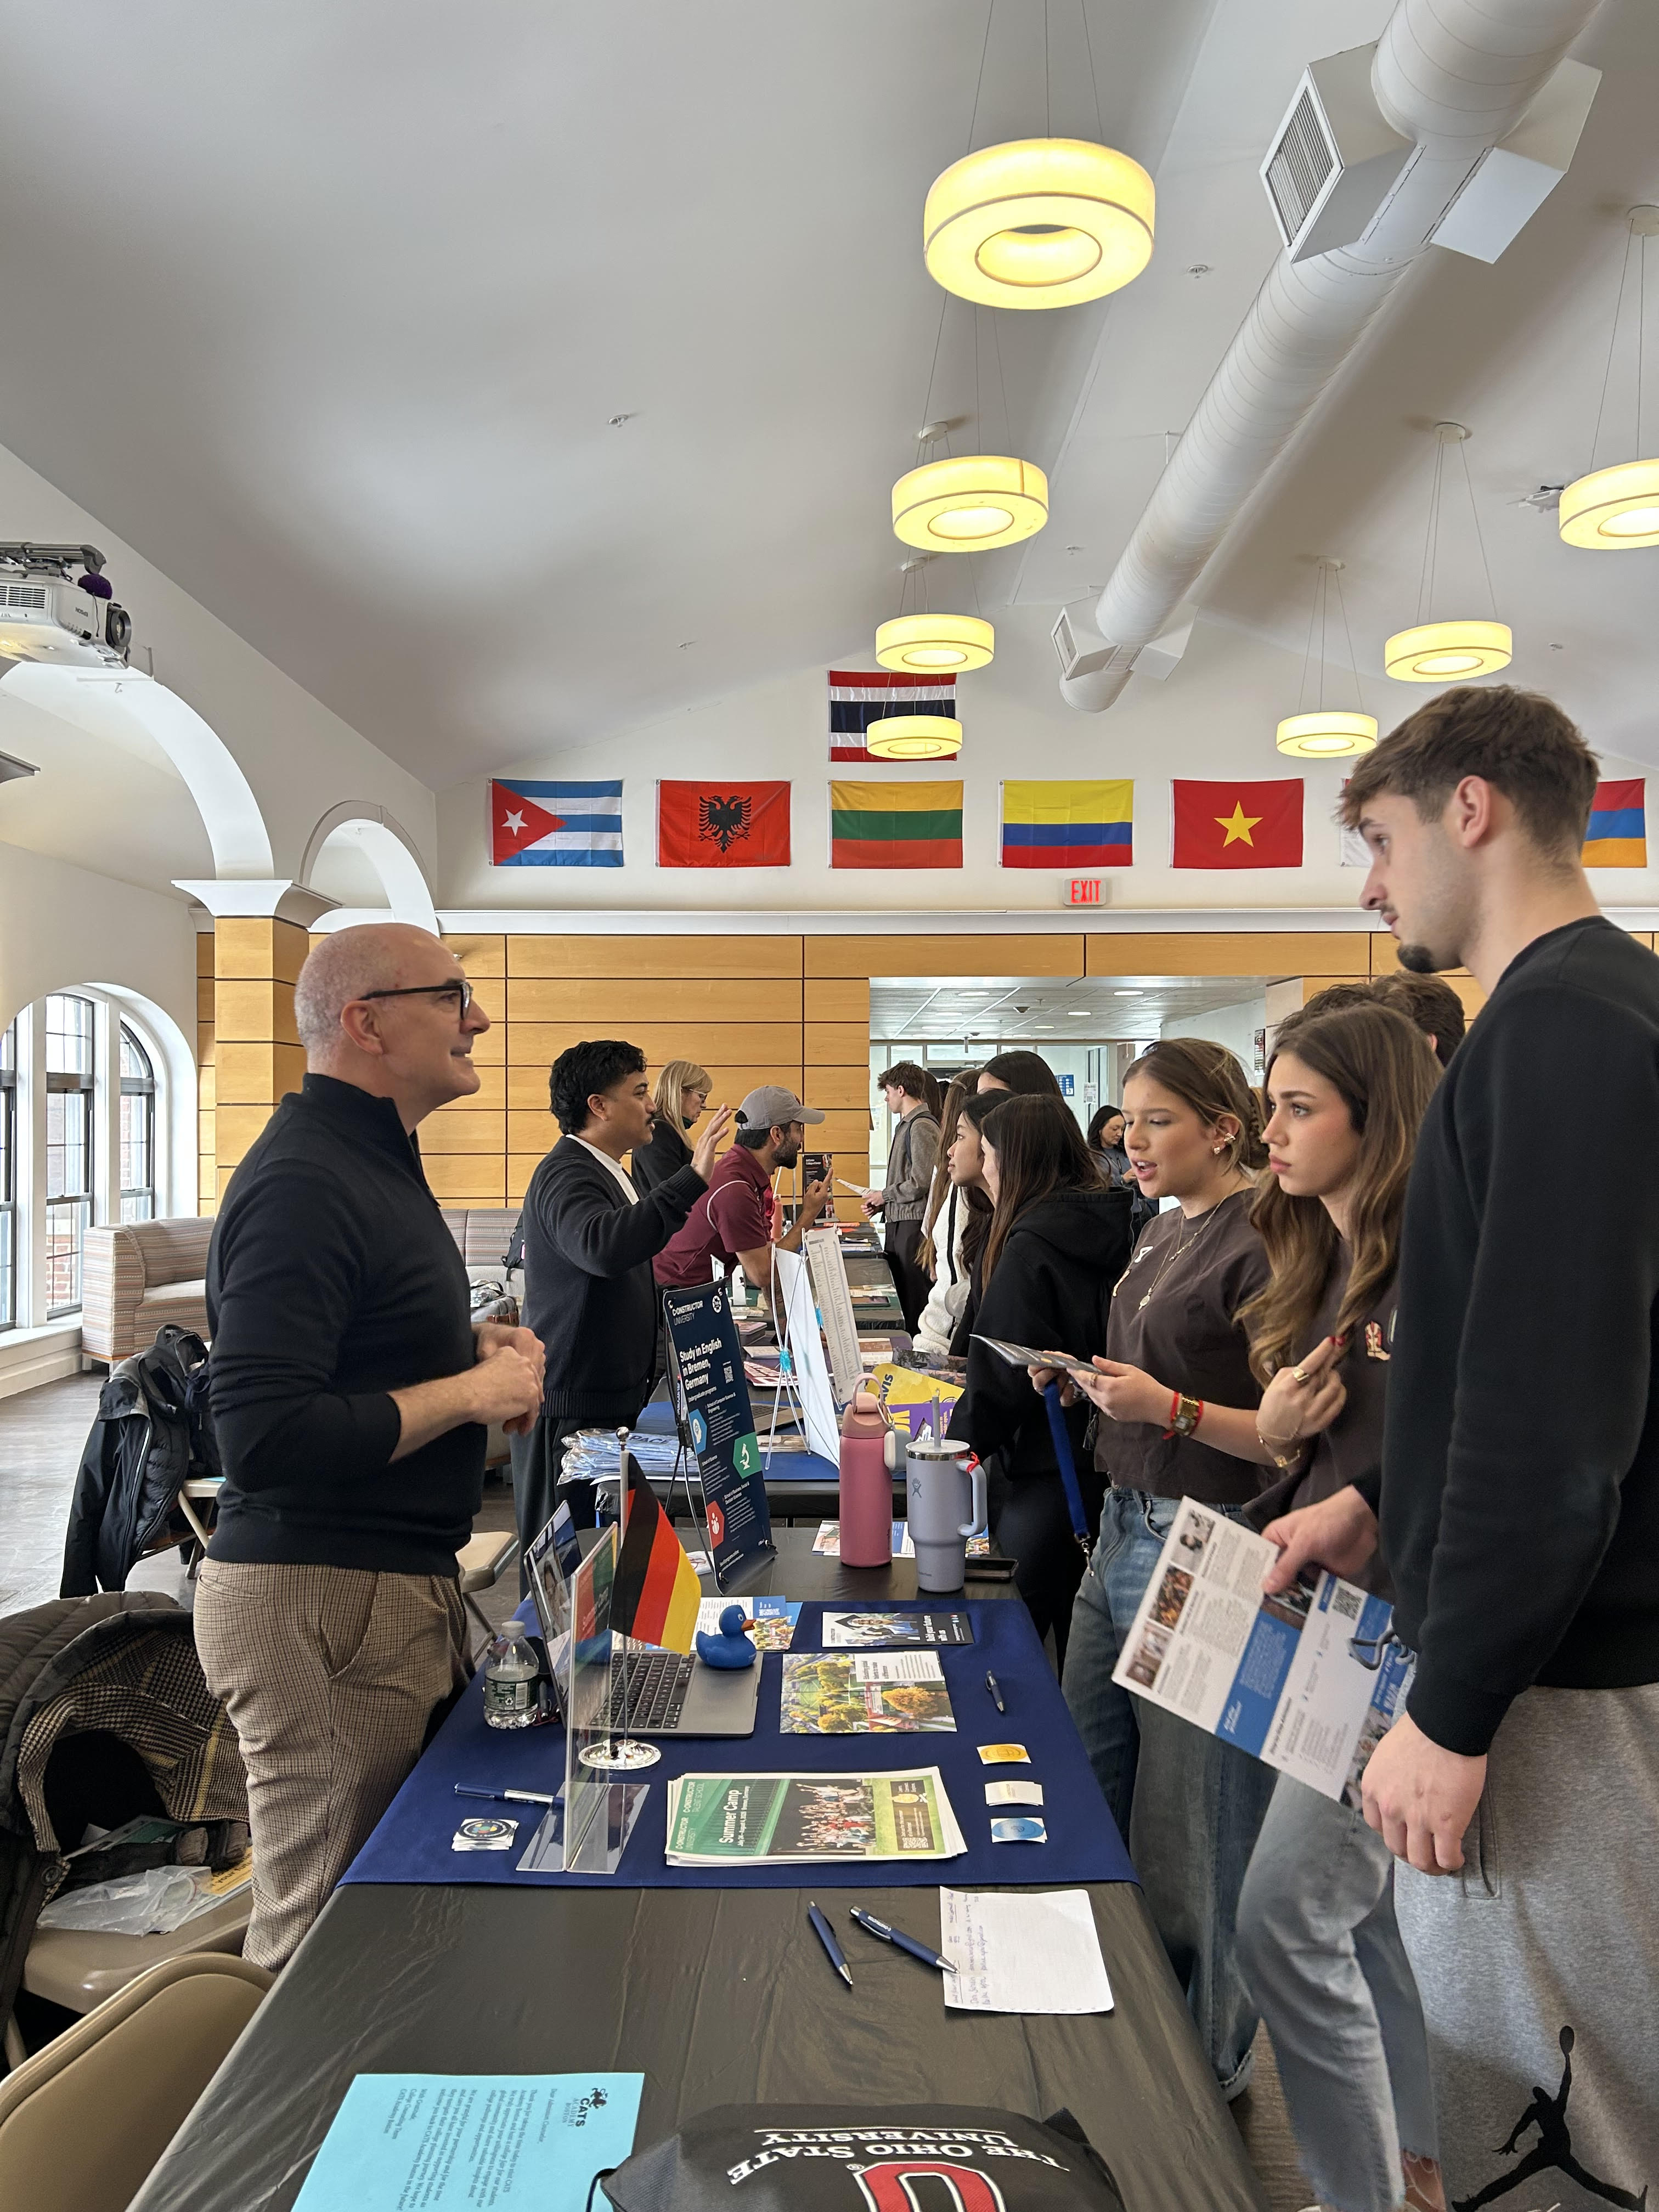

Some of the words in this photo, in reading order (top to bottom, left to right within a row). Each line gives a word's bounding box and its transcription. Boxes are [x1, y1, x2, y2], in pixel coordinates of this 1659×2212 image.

[1071, 880, 1101, 904] EXIT
[673, 1312, 695, 1325] UNIVERSITY
[680, 1346, 696, 1363] Study
[695, 1344, 702, 1356] in
[701, 1338, 722, 1355] English
[682, 1365, 688, 1376] in
[687, 1359, 711, 1374] Bremen,
[685, 1373, 709, 1390] Germany
[694, 1782, 705, 1798] SCHOOL
[691, 1798, 702, 1813] TALENT
[723, 1790, 742, 1810] Camp
[719, 1812, 736, 1843] Summer
[215, 1871, 235, 1883] your
[397, 2089, 407, 2100] CATS
[405, 2089, 417, 2103] College
[549, 2089, 558, 2098] Dear
[389, 2101, 402, 2118] Academy
[396, 2104, 411, 2126] Counseling
[562, 2103, 571, 2123] BOSTON
[567, 2098, 580, 2127] ACADEMY
[574, 2098, 590, 2127] CATS
[383, 2119, 394, 2134] Boston
[391, 2128, 402, 2139] Team
[762, 2131, 1019, 2147] UNIVERSITY
[865, 2143, 973, 2158] OHIO
[985, 2146, 1070, 2172] THE
[726, 2146, 855, 2186] STATE
